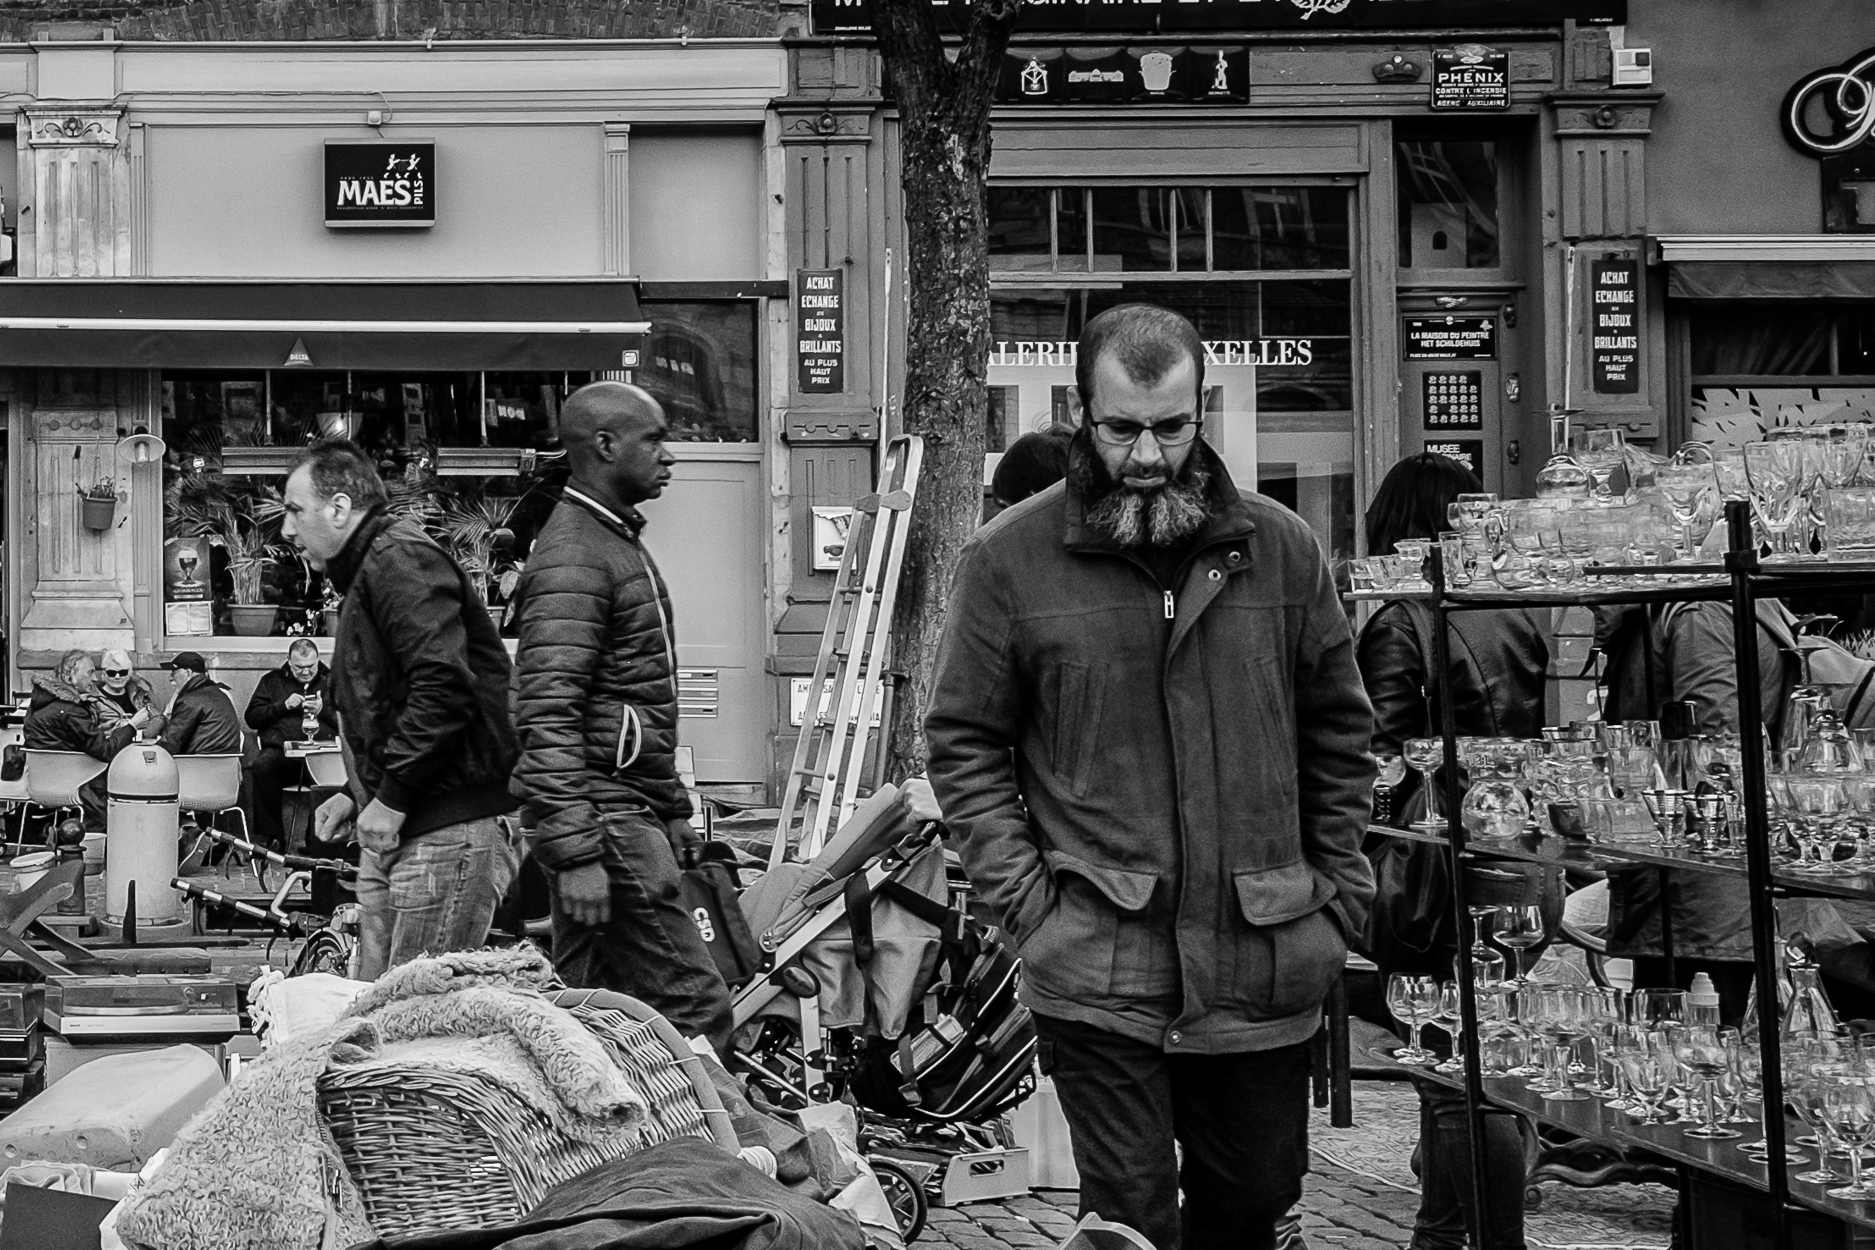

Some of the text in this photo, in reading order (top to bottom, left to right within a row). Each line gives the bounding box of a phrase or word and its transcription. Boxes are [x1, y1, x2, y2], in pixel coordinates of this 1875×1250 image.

[337, 180, 423, 206] MAES PILS
[806, 276, 834, 290] ACHAT
[1600, 271, 1629, 284] ACHAT
[801, 295, 839, 308] ECHANGE
[1595, 290, 1634, 303] ECHANGE
[805, 319, 836, 331] BIJOUX
[1599, 314, 1631, 327] BIJOUX
[800, 340, 842, 353] BRILLANTS
[1594, 336, 1637, 349] BRILLANTS
[987, 340, 1312, 366] ALERI XELLES
[817, 359, 838, 367] PLUS
[1427, 444, 1460, 453] MUSEE
